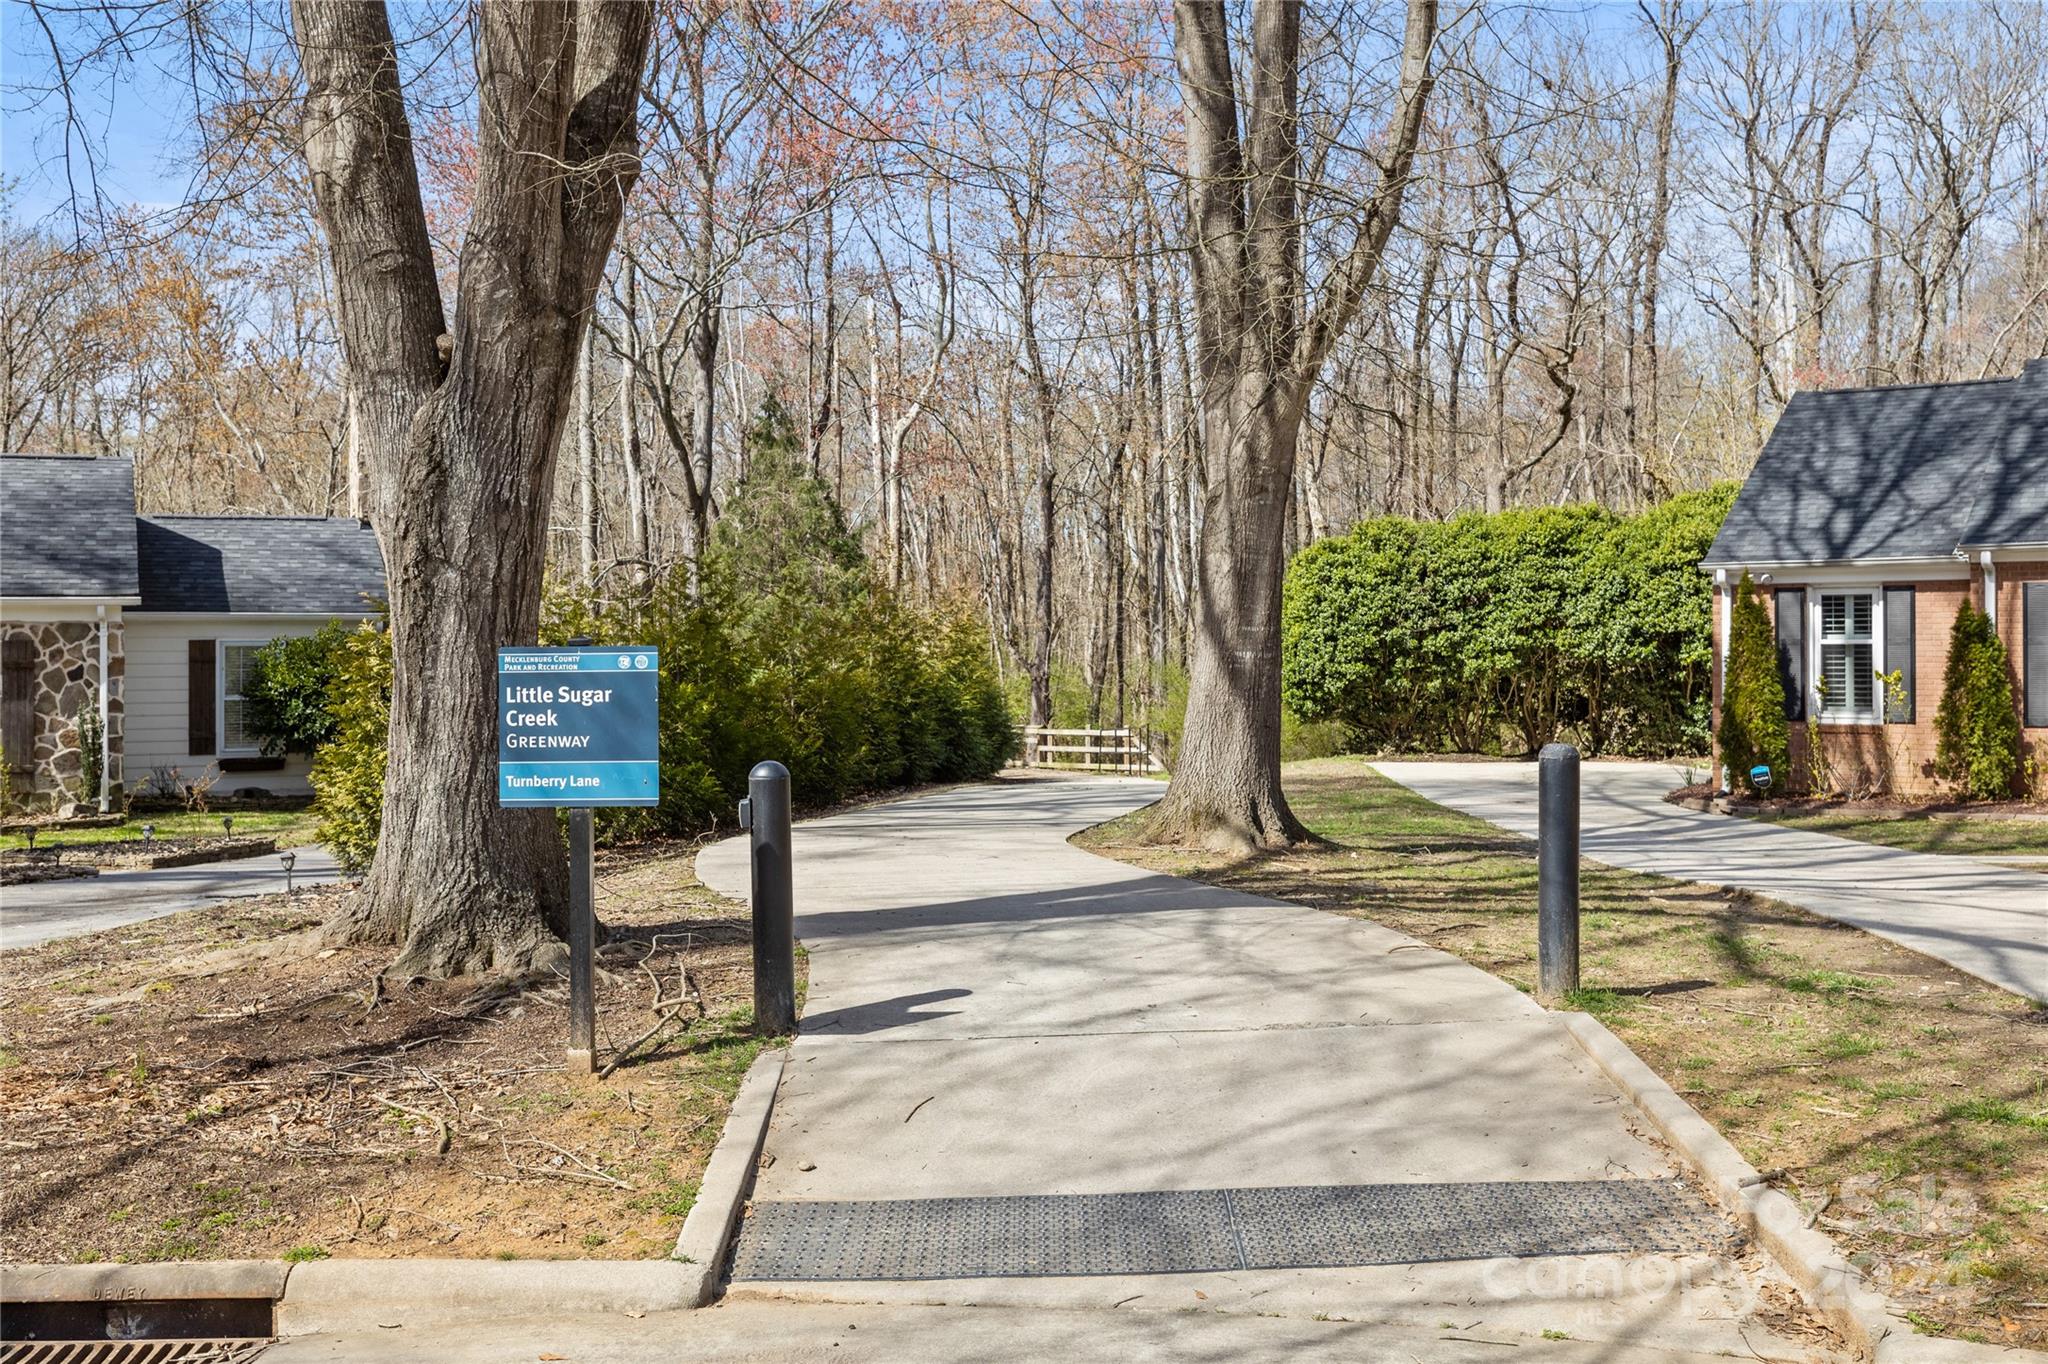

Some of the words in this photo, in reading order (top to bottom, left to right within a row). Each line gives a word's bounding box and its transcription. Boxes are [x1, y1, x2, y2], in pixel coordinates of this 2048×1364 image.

[504, 655, 552, 663] MECKLENBURG
[553, 655, 580, 663] COUNTY
[504, 663, 522, 671] PARK
[537, 663, 578, 671] RECREATION
[506, 686, 553, 703] Little
[558, 686, 613, 706] Sugar
[506, 709, 558, 727] Creek
[506, 734, 590, 748] GREENWAY
[505, 776, 567, 790] Turnberry
[570, 776, 600, 787] Lane
